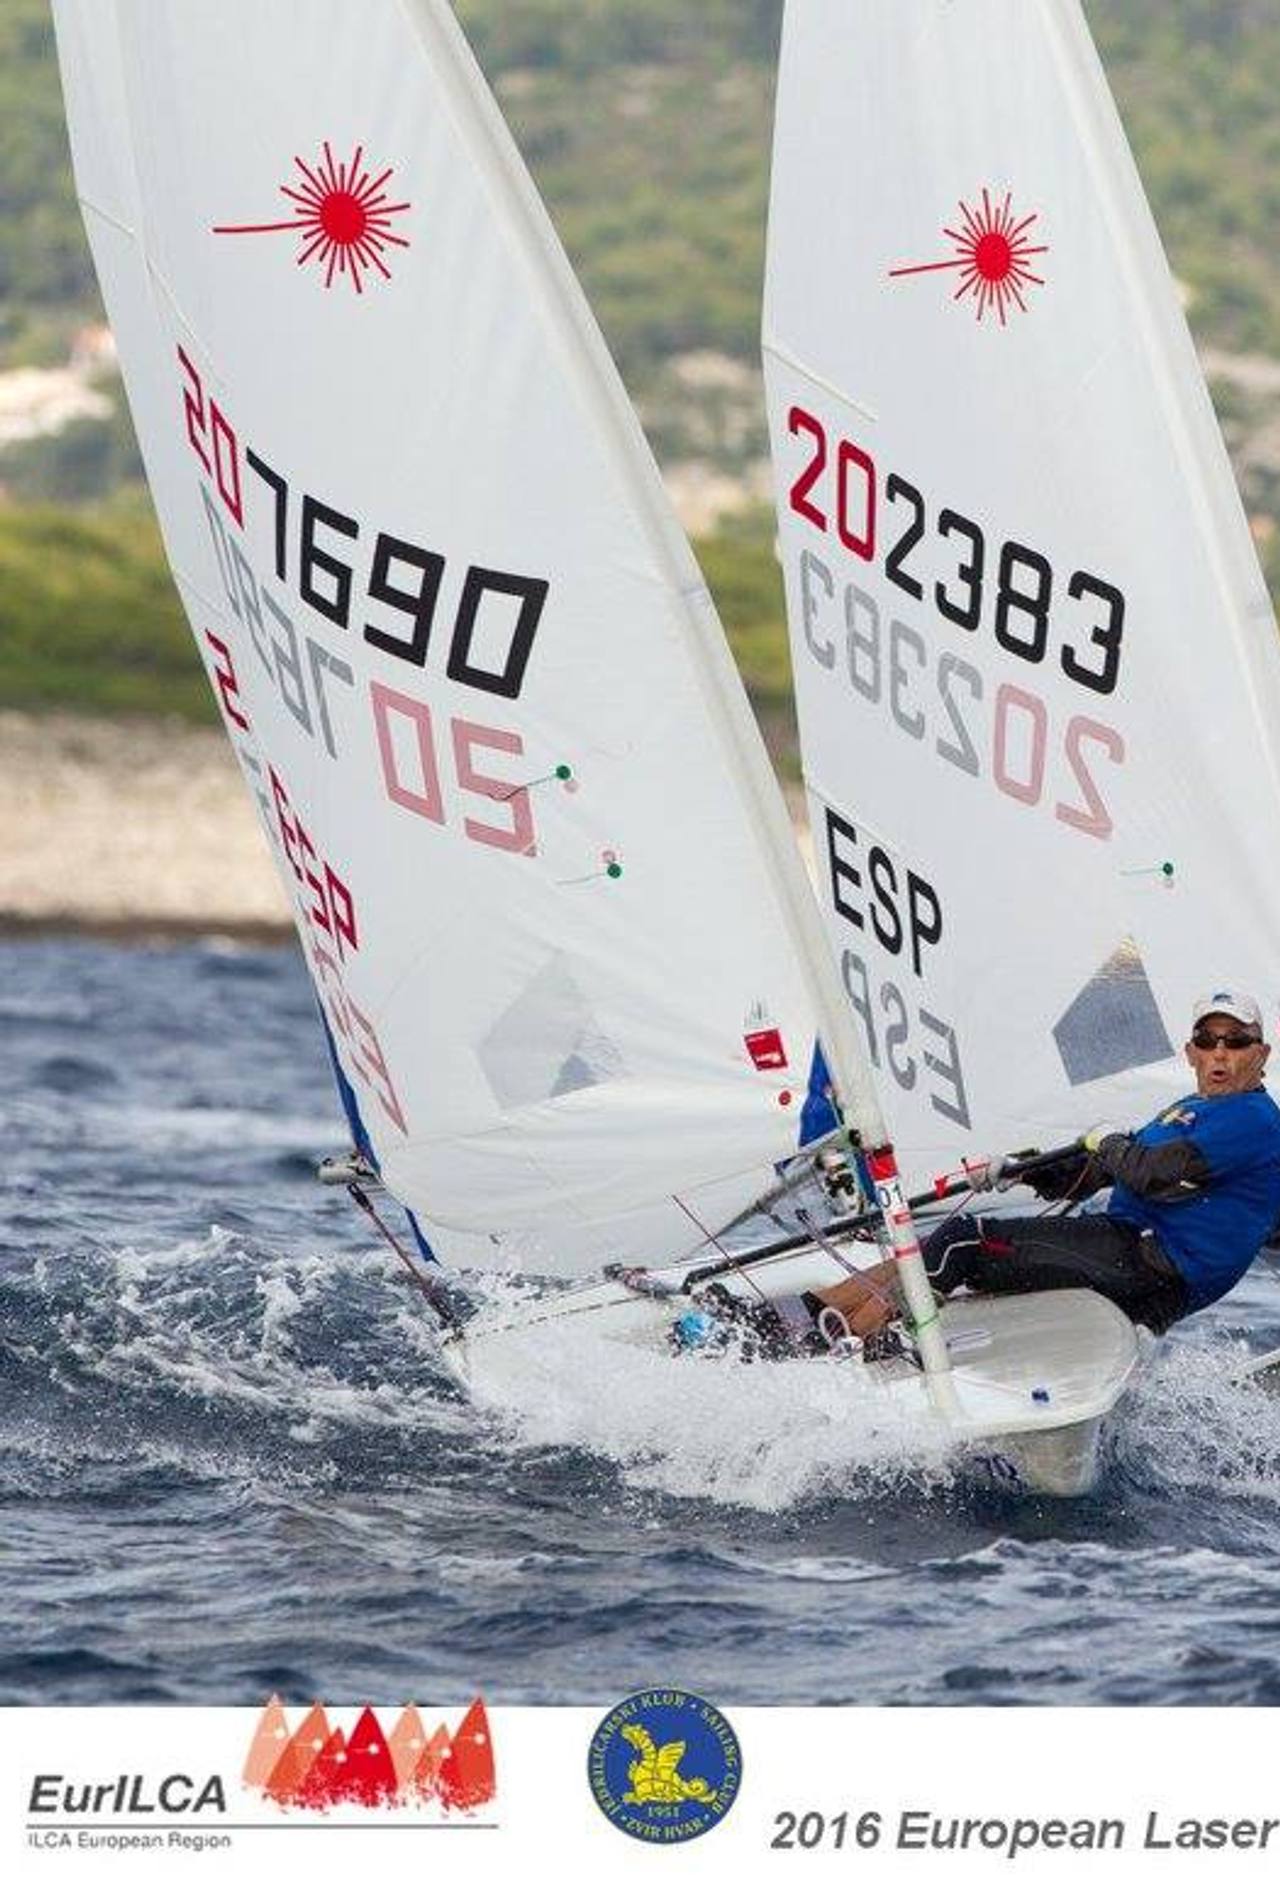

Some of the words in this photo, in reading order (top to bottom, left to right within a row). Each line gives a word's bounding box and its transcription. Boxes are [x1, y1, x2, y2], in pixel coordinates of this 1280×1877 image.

[178, 345, 551, 700] 207690
[787, 406, 1126, 694] 202383
[826, 806, 942, 976] ESP
